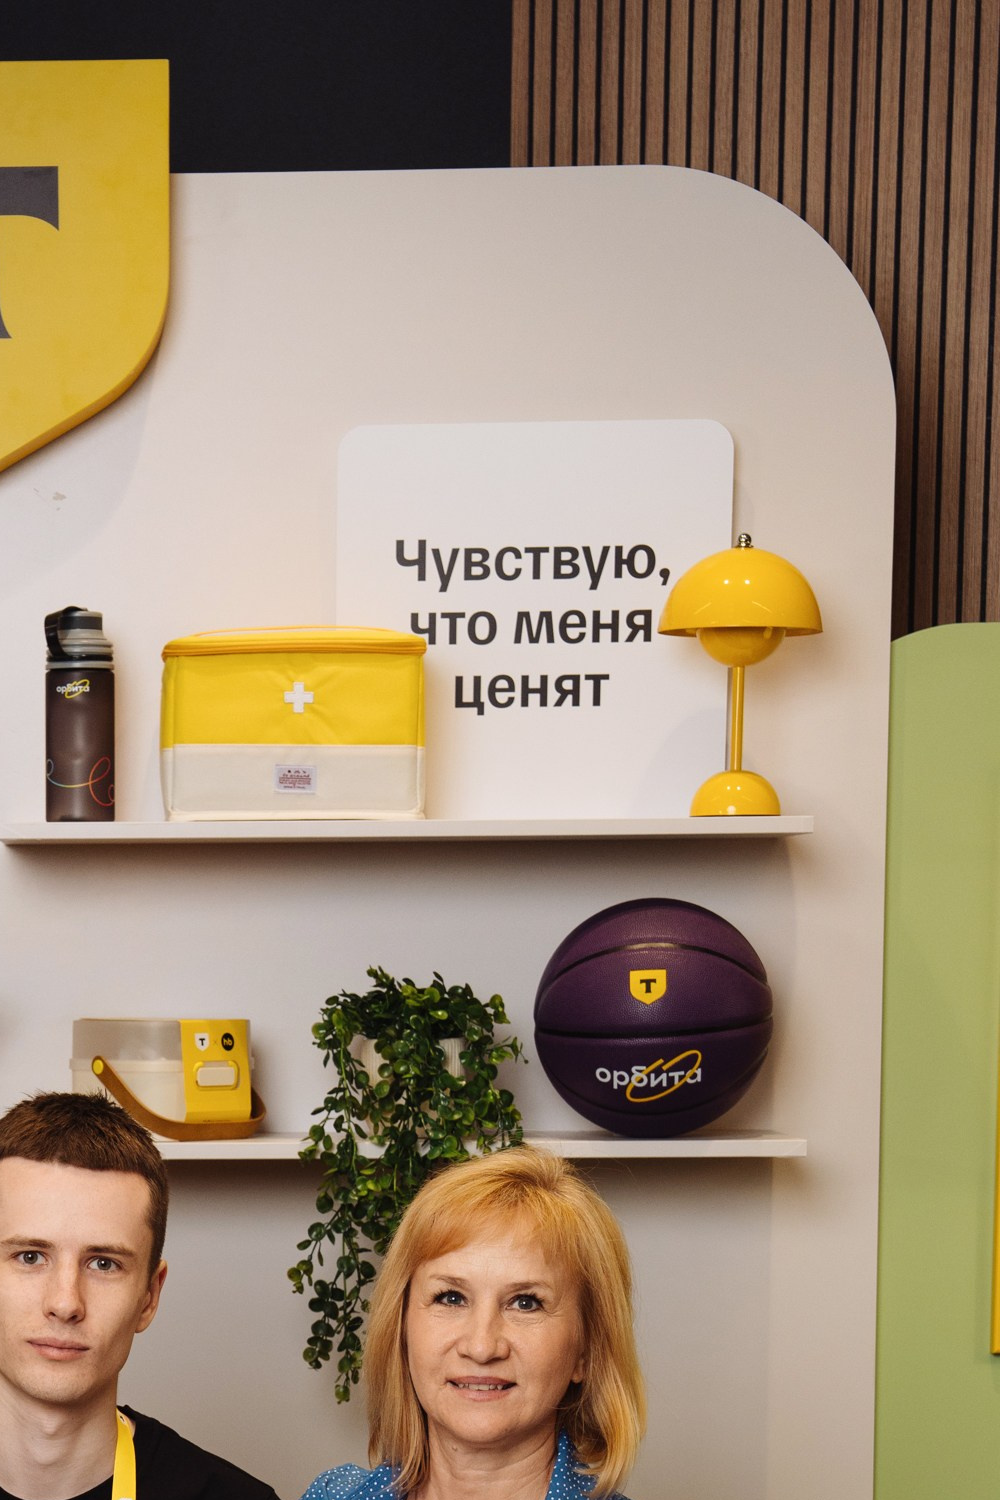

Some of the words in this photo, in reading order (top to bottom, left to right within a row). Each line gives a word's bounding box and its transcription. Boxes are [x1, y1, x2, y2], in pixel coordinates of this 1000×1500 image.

[395, 538, 671, 593] Чувствую,
[410, 610, 498, 646] что
[513, 609, 653, 645] меня
[56, 683, 90, 695] орбита
[454, 673, 610, 716] ценят
[640, 978, 657, 994] Т
[595, 1065, 702, 1090] орбита
